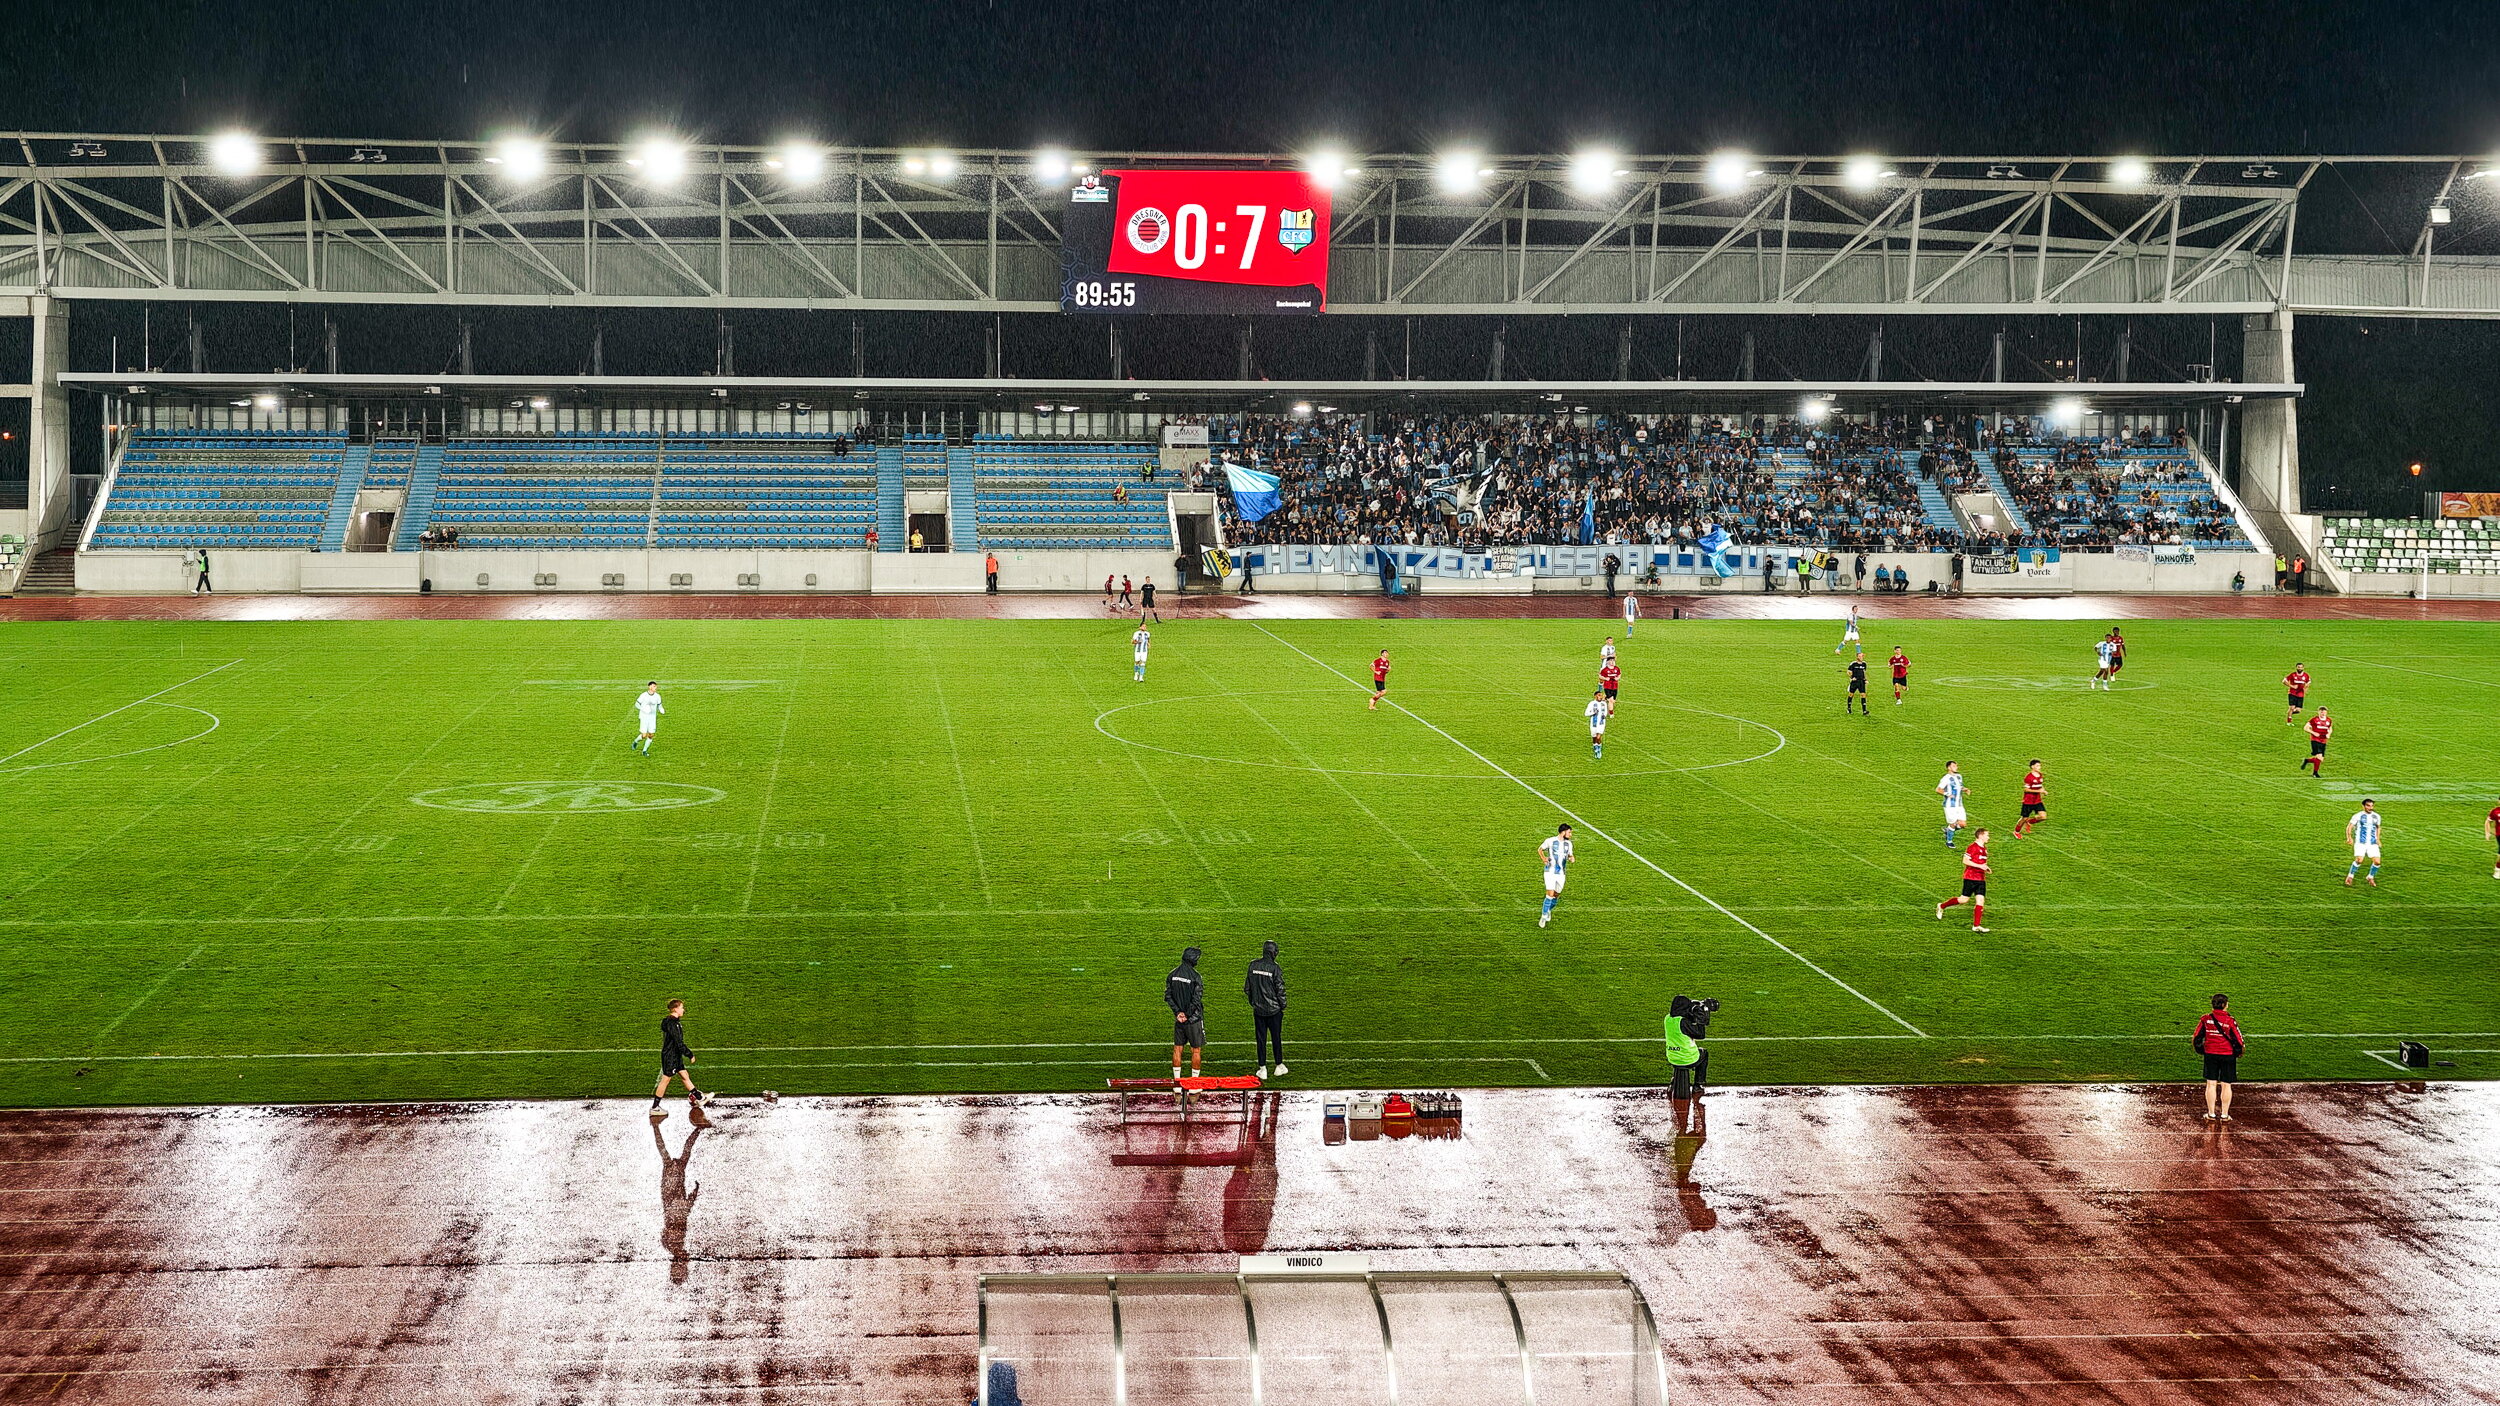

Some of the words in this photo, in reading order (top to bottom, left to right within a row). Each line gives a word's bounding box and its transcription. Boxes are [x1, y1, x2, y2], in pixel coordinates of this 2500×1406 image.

[1131, 209, 1167, 226] DRESDNER
[1282, 231, 1308, 242] CFC
[1075, 282, 1135, 306] 89:55
[1971, 557, 2004, 567] FANCLUB
[2155, 554, 2195, 563] HANNOVER
[1286, 1257, 1323, 1267] VINDICO
